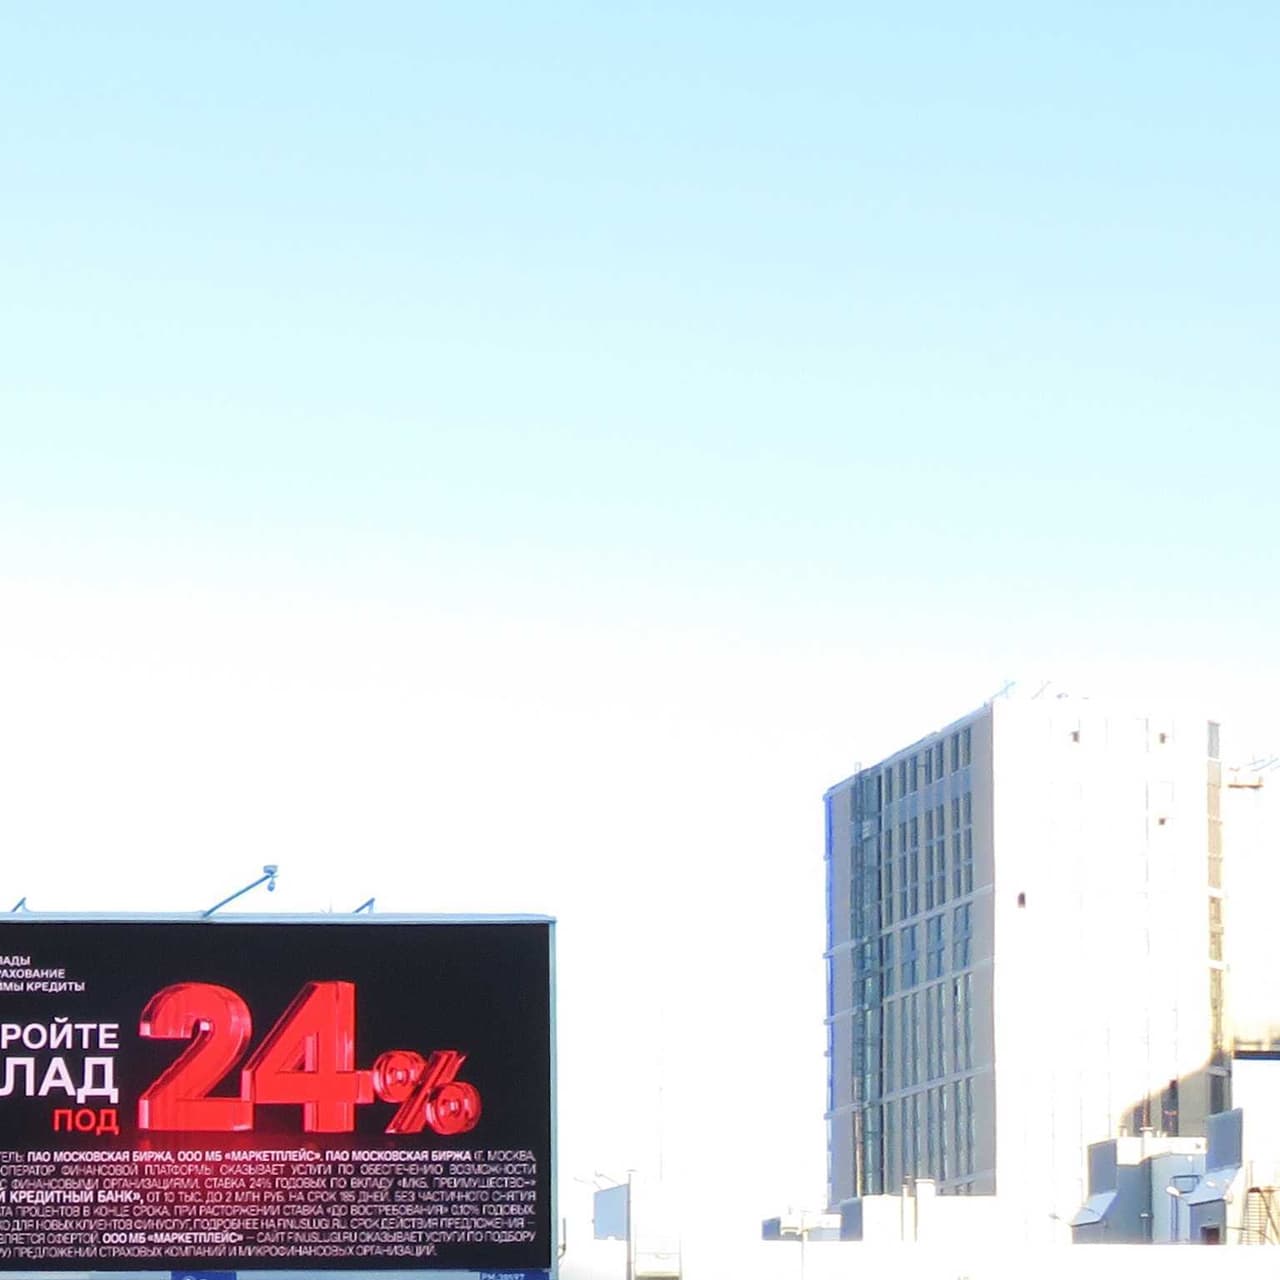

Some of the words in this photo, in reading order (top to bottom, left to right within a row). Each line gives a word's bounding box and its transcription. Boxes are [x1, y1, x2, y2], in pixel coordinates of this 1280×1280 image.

[26, 981, 86, 993] КРЕДИТЫ
[53, 1109, 120, 1134] ПОД
[27, 1152, 51, 1163] ПАО
[53, 1152, 130, 1163] МОСКОВСКАЯ
[133, 1151, 175, 1163] БИРЖА,
[177, 1151, 203, 1162] ООО
[205, 1151, 222, 1162] МБ
[325, 1151, 350, 1162] ПАО
[352, 1151, 428, 1162] МОСКОВСКАЯ
[431, 1151, 471, 1162] БИРЖА
[0, 1165, 55, 1176] ОПЕРАТОР
[61, 1165, 138, 1175] ФИНАНСОВОЙ
[144, 1165, 212, 1175] ПЛАТФОРМЫ
[220, 1165, 285, 1175] ОКАЗЫВАЕТ
[291, 1165, 332, 1175] УСЛУГИ
[338, 1164, 354, 1175] ПО
[360, 1164, 443, 1175] ОБЕСПЕЧЕНИЮ
[450, 1164, 536, 1175] ВОЗМОЖНОСТИ
[11, 1179, 99, 1190] ФИНАНСОВЫМИ
[204, 1179, 245, 1189] СТАВКА
[249, 1178, 272, 1189] 24%
[275, 1178, 326, 1189] ГОДОВЫХ
[330, 1178, 346, 1189] ПО
[350, 1178, 394, 1189] ВКЛАДУ
[9, 1189, 94, 1204] КРЕДИТНЫЙ
[97, 1191, 143, 1203] БАНК»,
[146, 1191, 159, 1202] ОТ
[178, 1191, 203, 1202] ТЫС.
[205, 1191, 220, 1202] ДО
[225, 1191, 232, 1202] 2
[235, 1191, 259, 1202] МЛН
[289, 1191, 303, 1202] НА
[307, 1190, 337, 1202] СРОК
[395, 1190, 415, 1202] БЕЗ
[418, 1190, 489, 1202] ЧАСТИЧНОГО
[492, 1190, 536, 1202] СНЯТИЯ
[15, 1206, 80, 1217] ПРОЦЕНТОВ
[83, 1206, 90, 1217] В
[93, 1206, 129, 1217] КОНЦЕ
[174, 1206, 197, 1216] ПРИ
[199, 1206, 280, 1216] РАСТОРЖЕНИИ
[282, 1206, 324, 1216] СТАВКА
[11, 1220, 34, 1230] ДЛЯ
[35, 1220, 75, 1230] НОВЫХ
[76, 1220, 132, 1230] КЛИЕНТОВ
[193, 1219, 259, 1230] ПОДРОБНЕЕ
[260, 1219, 276, 1230] НА
[350, 1219, 380, 1229] СРОК
[381, 1218, 438, 1229] ДЕЙСТВИЯ
[440, 1218, 525, 1229] ПРЕДЛОЖЕНИЯ
[102, 1234, 127, 1244] ООО
[128, 1234, 146, 1244] МБ
[148, 1232, 243, 1243] «МАРКЕТПЛЕЙС»
[256, 1233, 283, 1244] САЙТ
[359, 1233, 423, 1243] ОКАЗЫВАЕТ
[424, 1232, 465, 1243] УСЛУГИ
[467, 1232, 483, 1243] ПО
[485, 1232, 536, 1243] ПОДБОРУ
[13, 1248, 97, 1258] ПРЕДЛОЖЕНИЙ
[99, 1247, 162, 1258] СТРАХОВЫХ
[164, 1247, 226, 1257] КОМПАНИЙ
[228, 1247, 237, 1257] И
[238, 1246, 354, 1257] МИКРОФИНАНСОВЫХ
